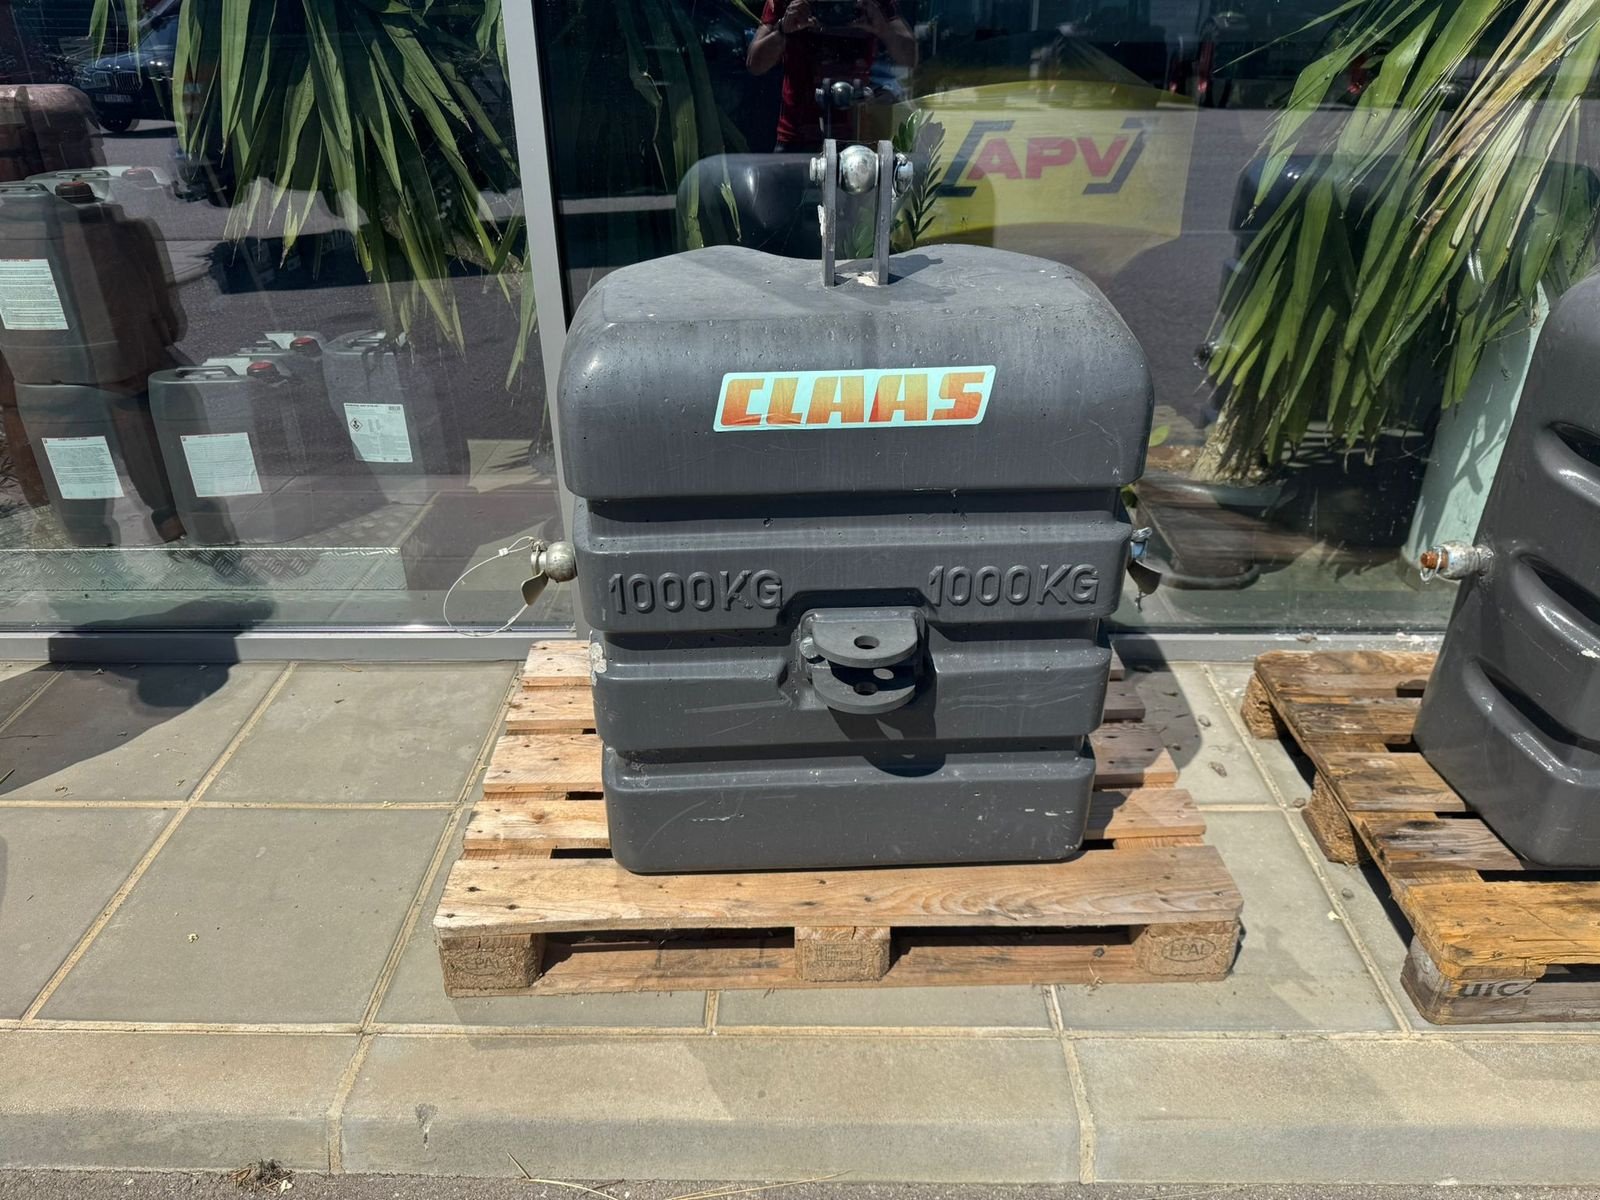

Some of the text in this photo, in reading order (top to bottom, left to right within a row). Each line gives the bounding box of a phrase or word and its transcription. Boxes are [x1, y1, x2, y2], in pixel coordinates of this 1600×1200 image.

[966, 136, 1130, 181] APV
[720, 371, 985, 426] CLAAS
[608, 569, 783, 615] 1000KG
[928, 563, 1100, 607] 1000KG
[1169, 943, 1212, 957] EPAL
